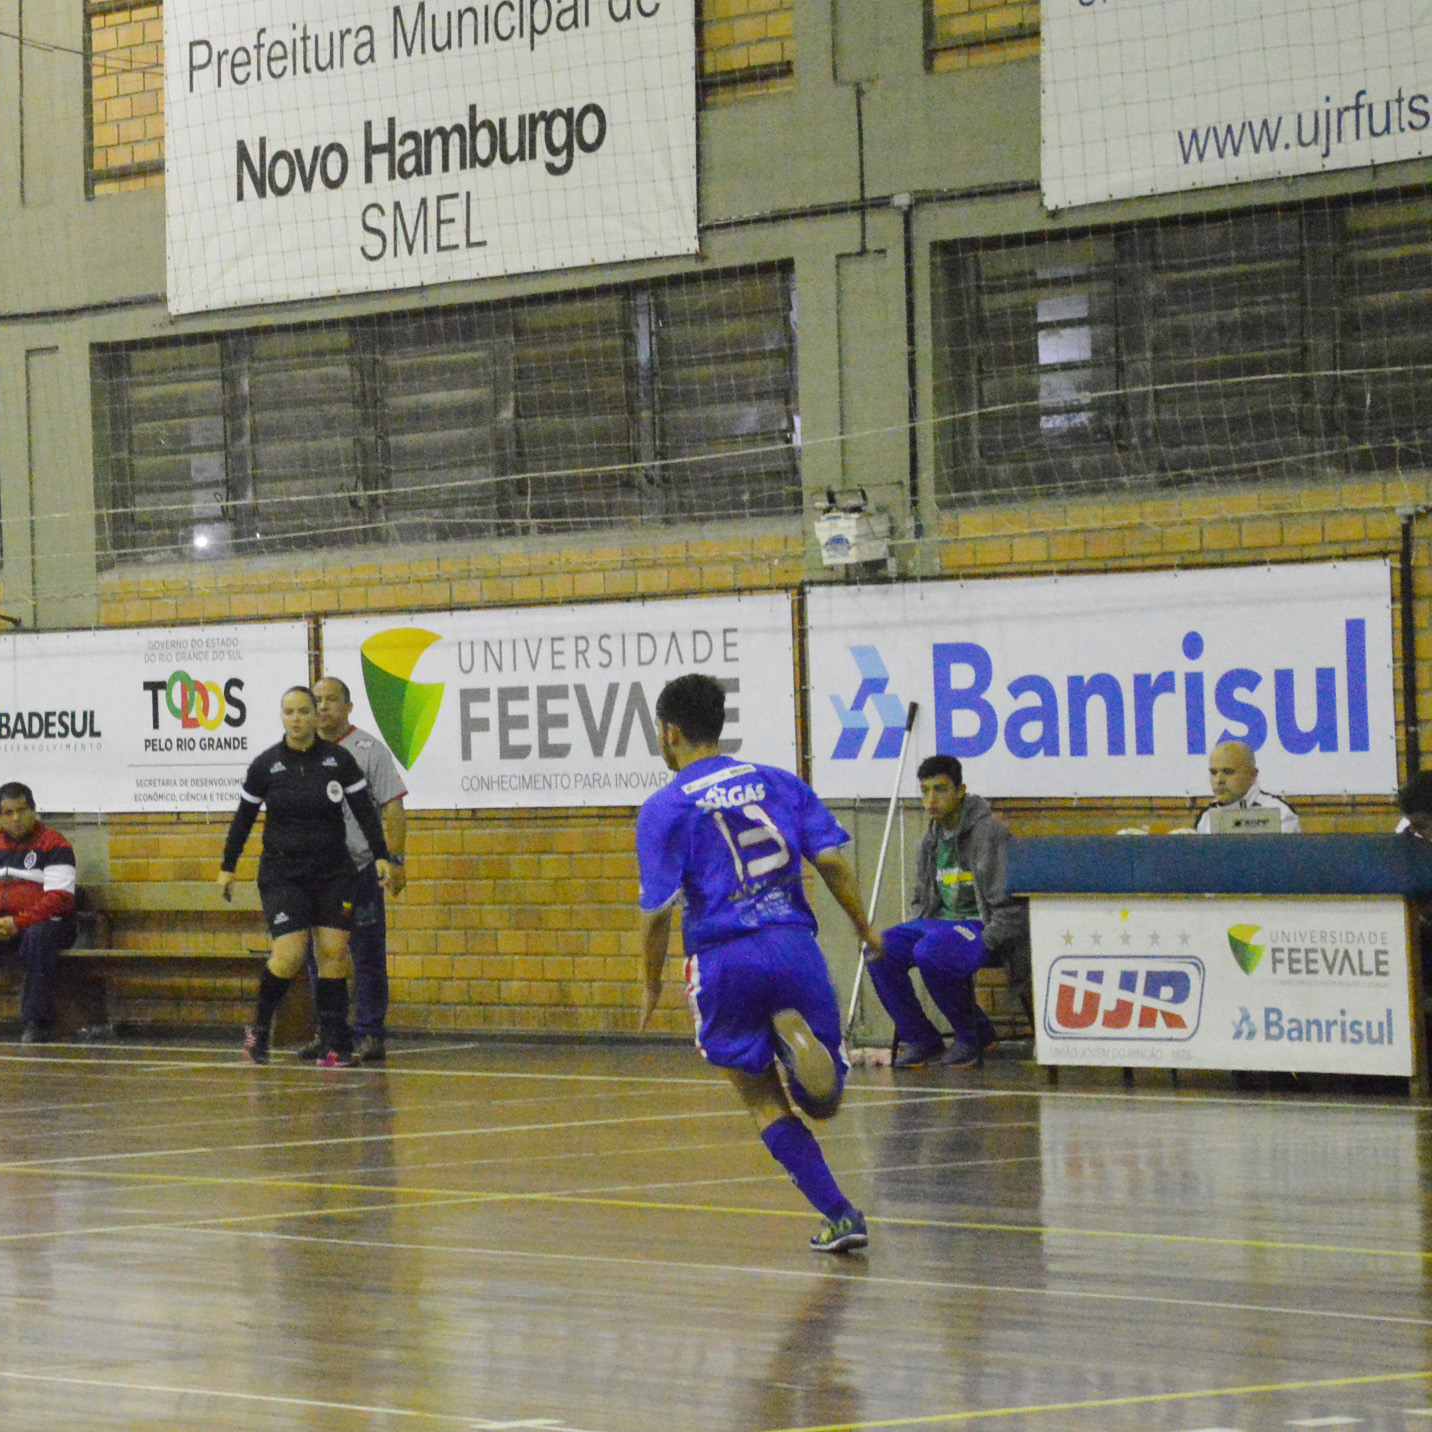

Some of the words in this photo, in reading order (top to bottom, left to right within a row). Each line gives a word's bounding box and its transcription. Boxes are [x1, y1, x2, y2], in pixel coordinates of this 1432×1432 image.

[188, 22, 376, 92] Prefeitura
[392, 0, 590, 59] Municipal
[236, 136, 349, 202] Novo
[364, 103, 607, 184] Hamburgo
[360, 191, 488, 261] SMEL
[144, 653, 156, 663] DO
[159, 652, 173, 663] RIO
[175, 651, 210, 662] GRANDE
[212, 650, 225, 661] DO
[228, 650, 243, 660] SUL
[148, 640, 188, 651] GOVERNO
[191, 639, 203, 649] DO
[206, 637, 239, 648] ESTADO
[457, 628, 740, 674] UNIVERSIDADE
[143, 670, 247, 731] TODOS
[932, 618, 1370, 759] Banrisul
[459, 677, 743, 762] FEEVAE
[144, 738, 173, 752] PELO
[177, 738, 196, 751] RIO
[199, 736, 248, 751] GRANDE
[135, 778, 177, 787] SECRETARIA
[179, 778, 189, 787] DE
[461, 773, 571, 792] CONHECIMENTO
[574, 772, 611, 789] PARA
[615, 770, 669, 788] INOVAR
[713, 803, 790, 883] 13
[1270, 929, 1389, 945] UNIVERSIDADE
[1271, 947, 1389, 977] FEEVALE
[1055, 969, 1190, 1030] UJR
[1264, 1007, 1394, 1045] Banrisul
